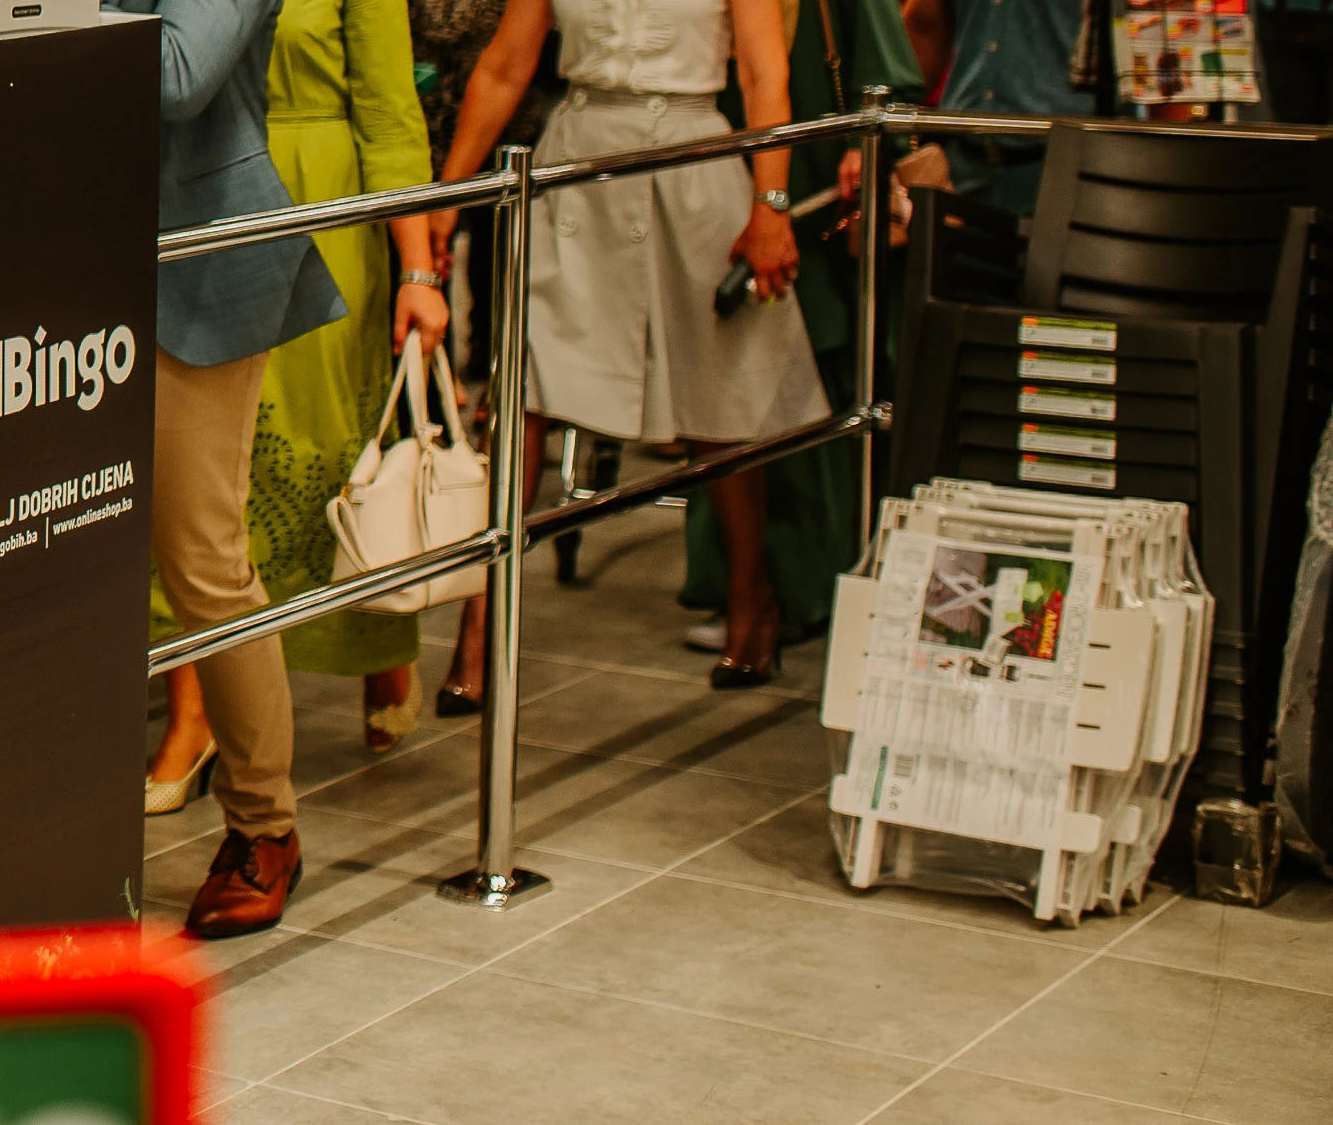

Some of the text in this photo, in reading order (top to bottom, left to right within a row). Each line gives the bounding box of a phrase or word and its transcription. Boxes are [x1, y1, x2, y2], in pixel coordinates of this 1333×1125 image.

[3, 324, 137, 417] Bingo
[19, 478, 79, 522] DOBRIH
[81, 459, 135, 501] CIJENA
[52, 496, 134, 536] www.onlineshop.ba
